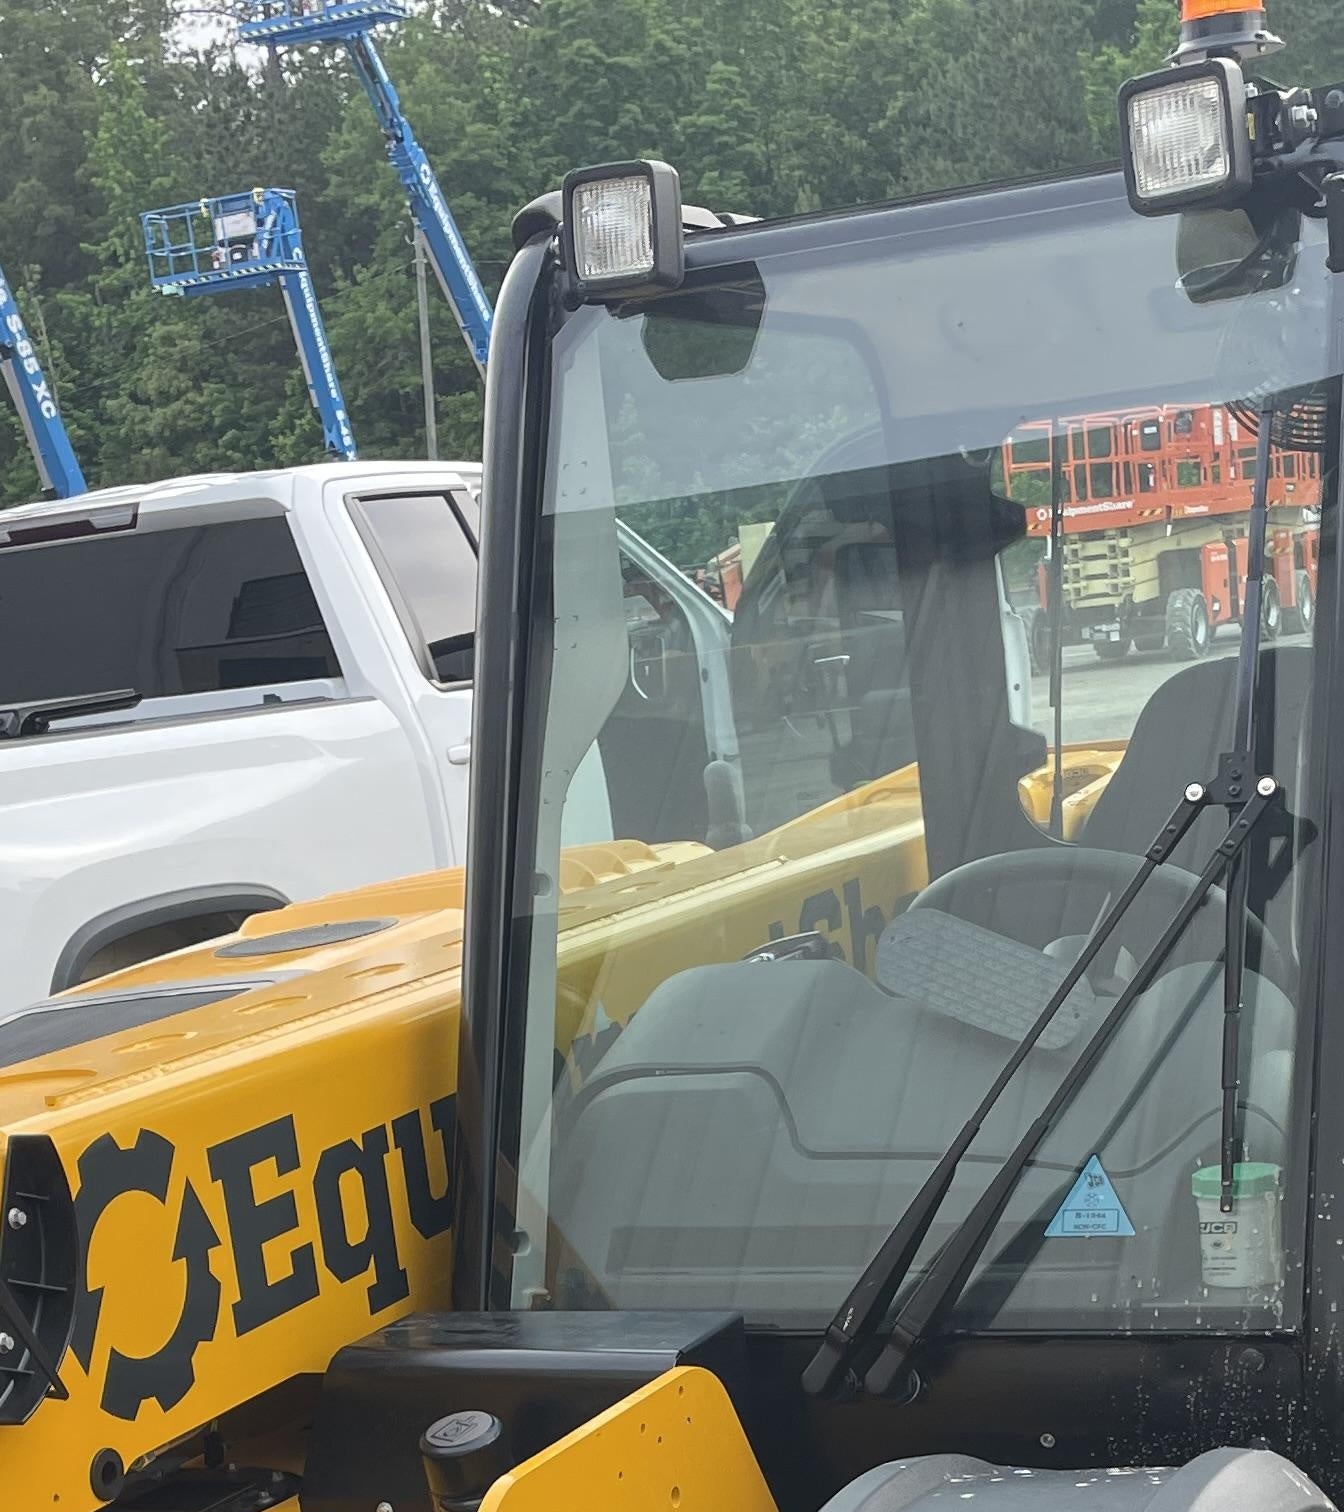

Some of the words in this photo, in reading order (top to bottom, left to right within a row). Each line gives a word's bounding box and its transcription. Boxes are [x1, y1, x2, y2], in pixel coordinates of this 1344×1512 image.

[6, 313, 41, 375] S-85
[32, 380, 57, 419] XC
[1200, 1223, 1236, 1233] JCB
